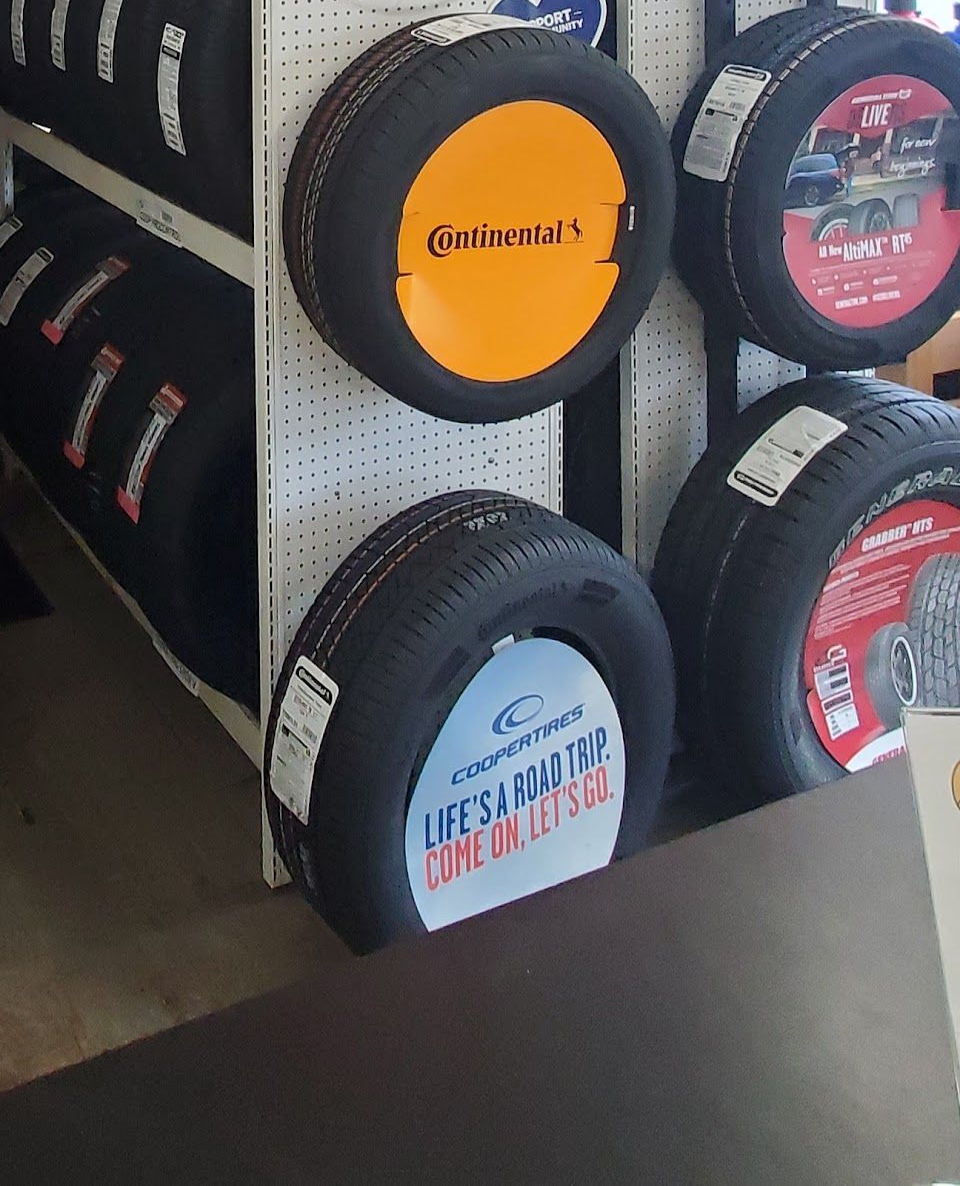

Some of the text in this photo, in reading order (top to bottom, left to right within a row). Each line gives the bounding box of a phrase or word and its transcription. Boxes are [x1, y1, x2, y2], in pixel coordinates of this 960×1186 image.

[529, 8, 572, 27] PORT
[552, 18, 584, 33] UNITY
[860, 103, 892, 128] LIVE
[427, 219, 563, 258] Continental
[424, 726, 611, 850] LIFE'S A ROAD TRIP.
[424, 765, 615, 892] COME ON, LET'S GO.
